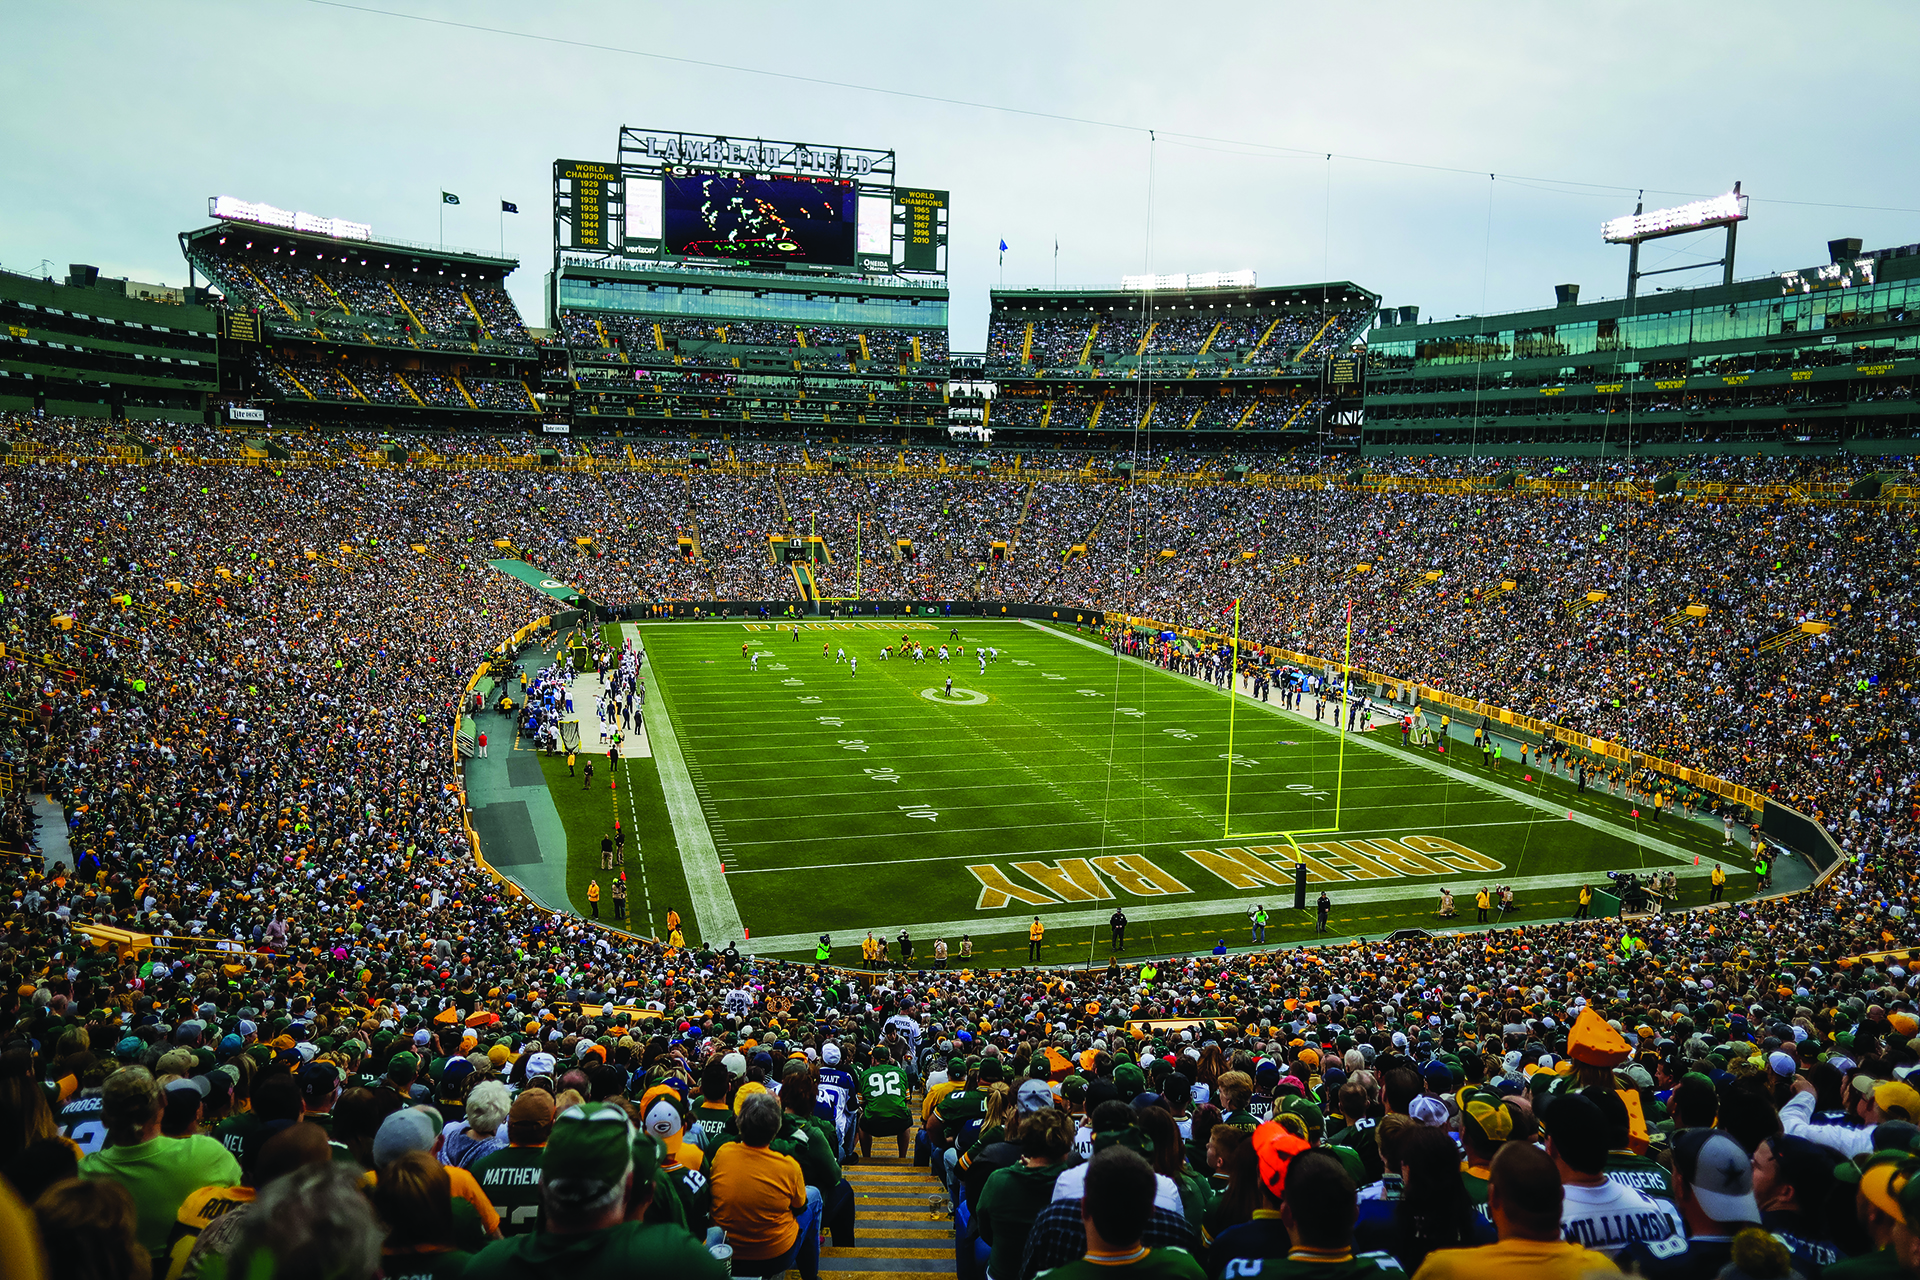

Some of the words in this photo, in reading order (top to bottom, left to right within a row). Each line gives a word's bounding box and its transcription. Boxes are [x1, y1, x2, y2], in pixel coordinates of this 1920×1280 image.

[646, 137, 781, 168] LAMBEAU
[795, 149, 873, 175] FIELD
[575, 164, 605, 173] WORLD
[565, 171, 615, 181] CHAMPIONS
[580, 180, 599, 188] 1929
[580, 188, 599, 196] 1930
[908, 191, 935, 199] WORLD
[580, 196, 597, 204] 1931
[900, 197, 943, 207] CHAMPIONS
[580, 204, 599, 212] 1936
[913, 206, 930, 214] 1965
[580, 212, 599, 220] 1939
[580, 220, 599, 228] 1944
[580, 237, 599, 245] 1962
[625, 245, 656, 254] verizon
[1162, 728, 1199, 739] 30
[837, 738, 870, 750] 30
[1218, 752, 1261, 765] 20
[863, 767, 901, 781] 20
[1285, 783, 1331, 797] 10
[897, 803, 939, 819] 10
[1179, 834, 1507, 890] GREEN
[964, 853, 1196, 910] BAY
[868, 1070, 902, 1098] 92
[682, 1169, 707, 1194] 12
